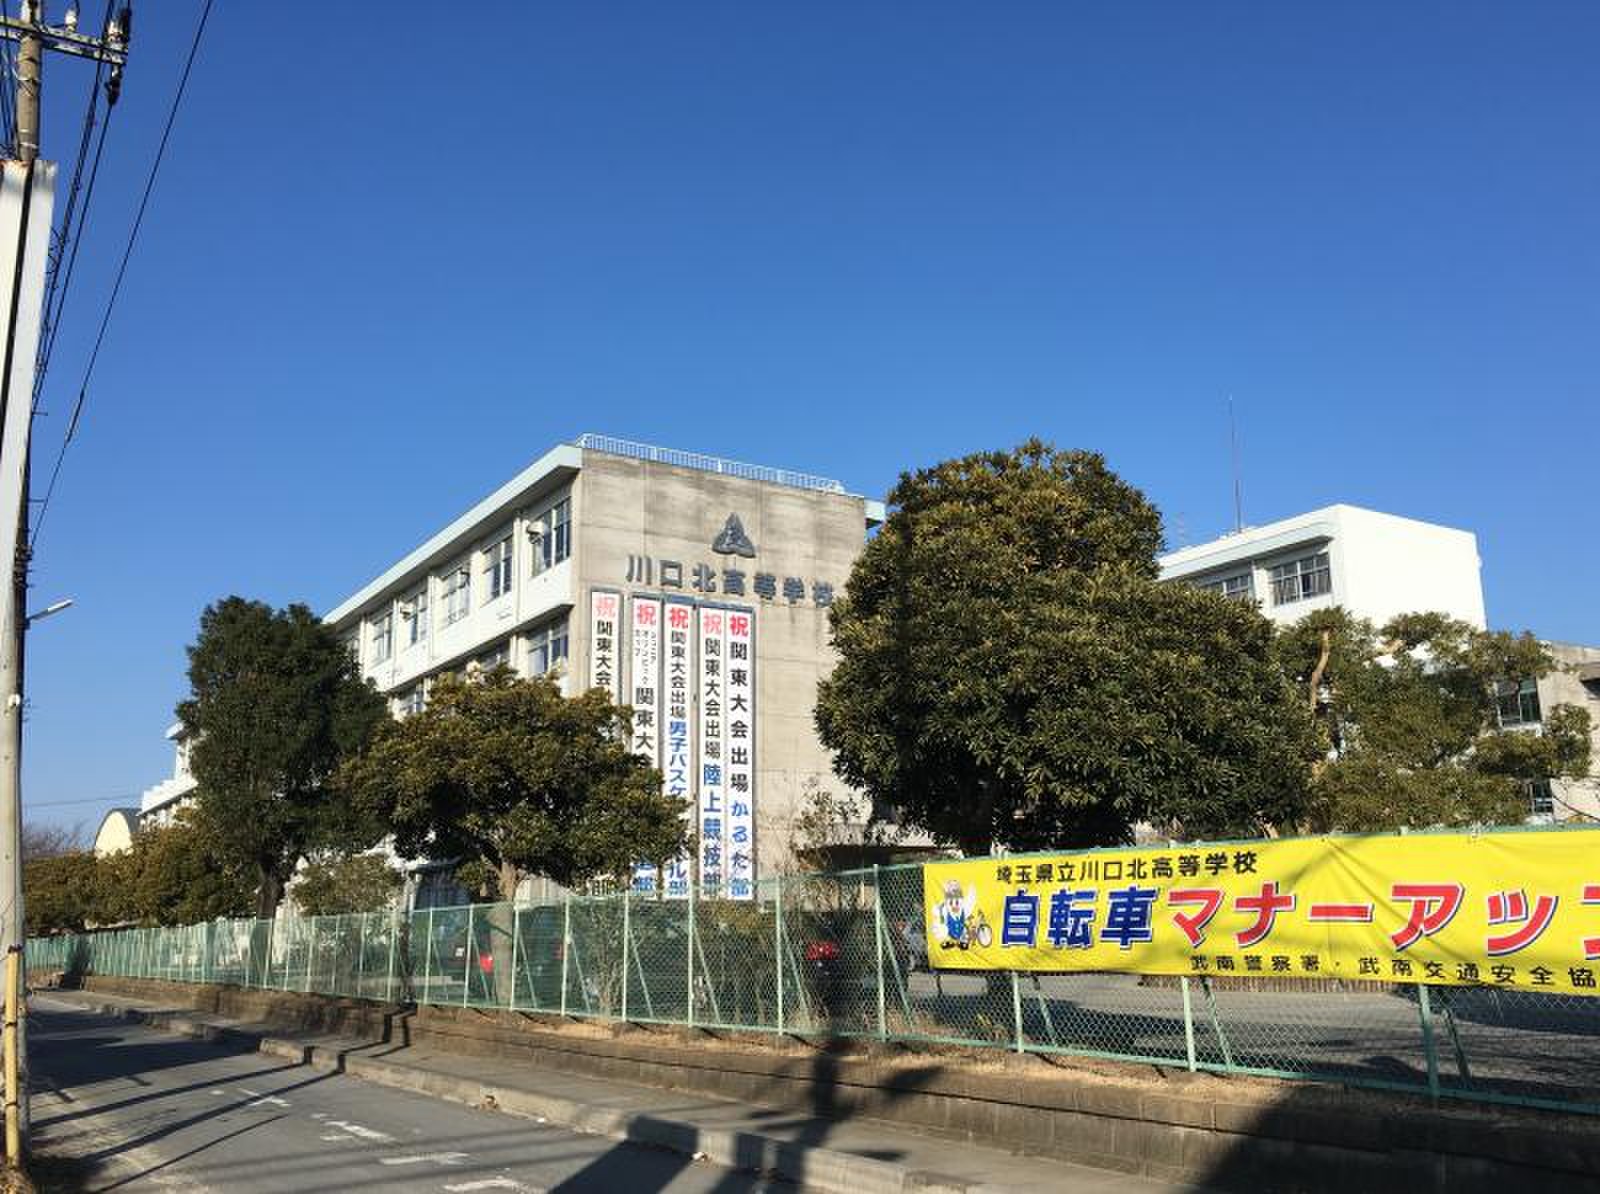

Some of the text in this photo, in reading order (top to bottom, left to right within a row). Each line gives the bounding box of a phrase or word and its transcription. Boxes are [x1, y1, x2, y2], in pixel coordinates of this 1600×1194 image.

[996, 851, 1258, 885] 埼玉県立川口北高等学校
